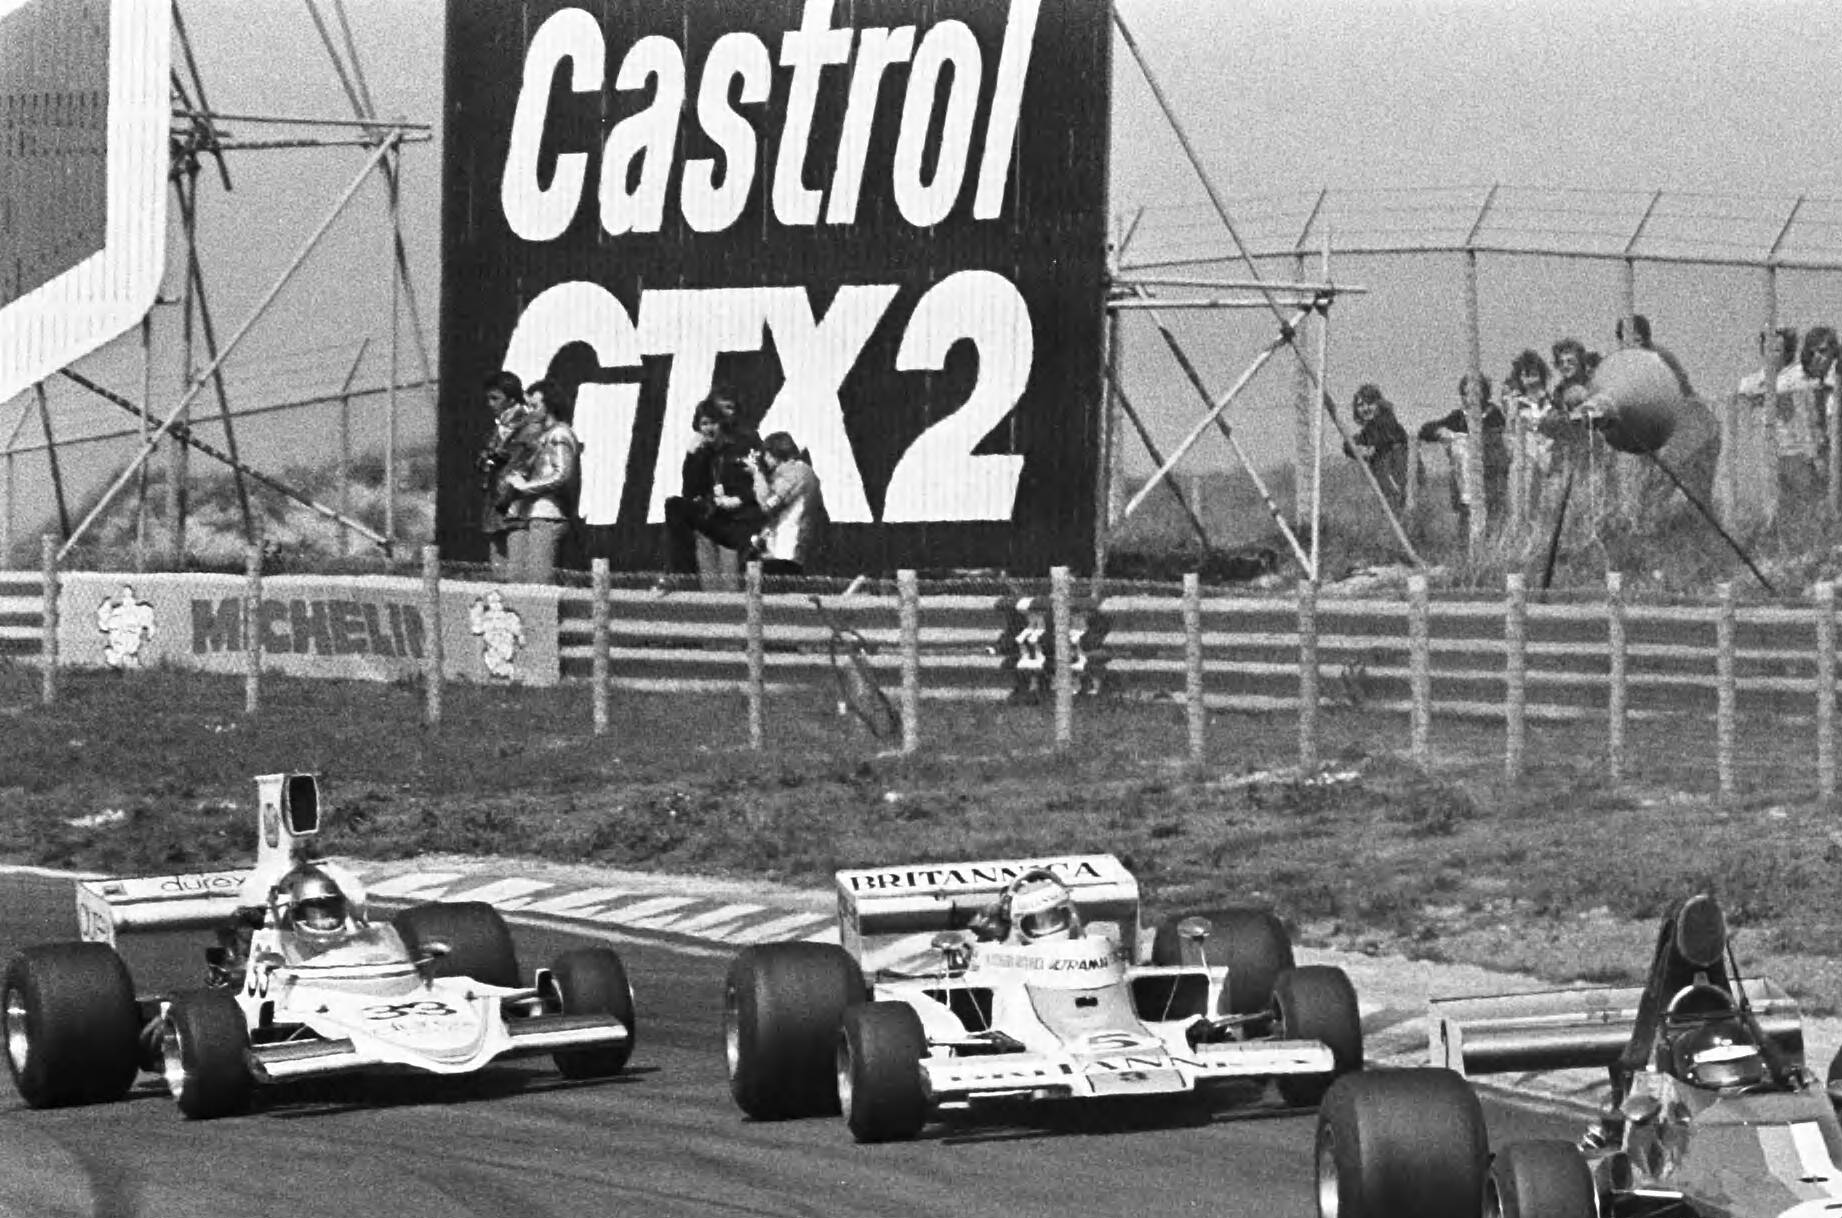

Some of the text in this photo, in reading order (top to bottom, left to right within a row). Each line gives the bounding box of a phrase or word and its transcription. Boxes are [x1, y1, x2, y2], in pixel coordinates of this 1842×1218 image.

[501, 0, 1041, 242] Castrol
[501, 269, 1033, 525] GTX2
[850, 861, 1102, 891] BRITANNCA
[362, 1000, 457, 1021] 33
